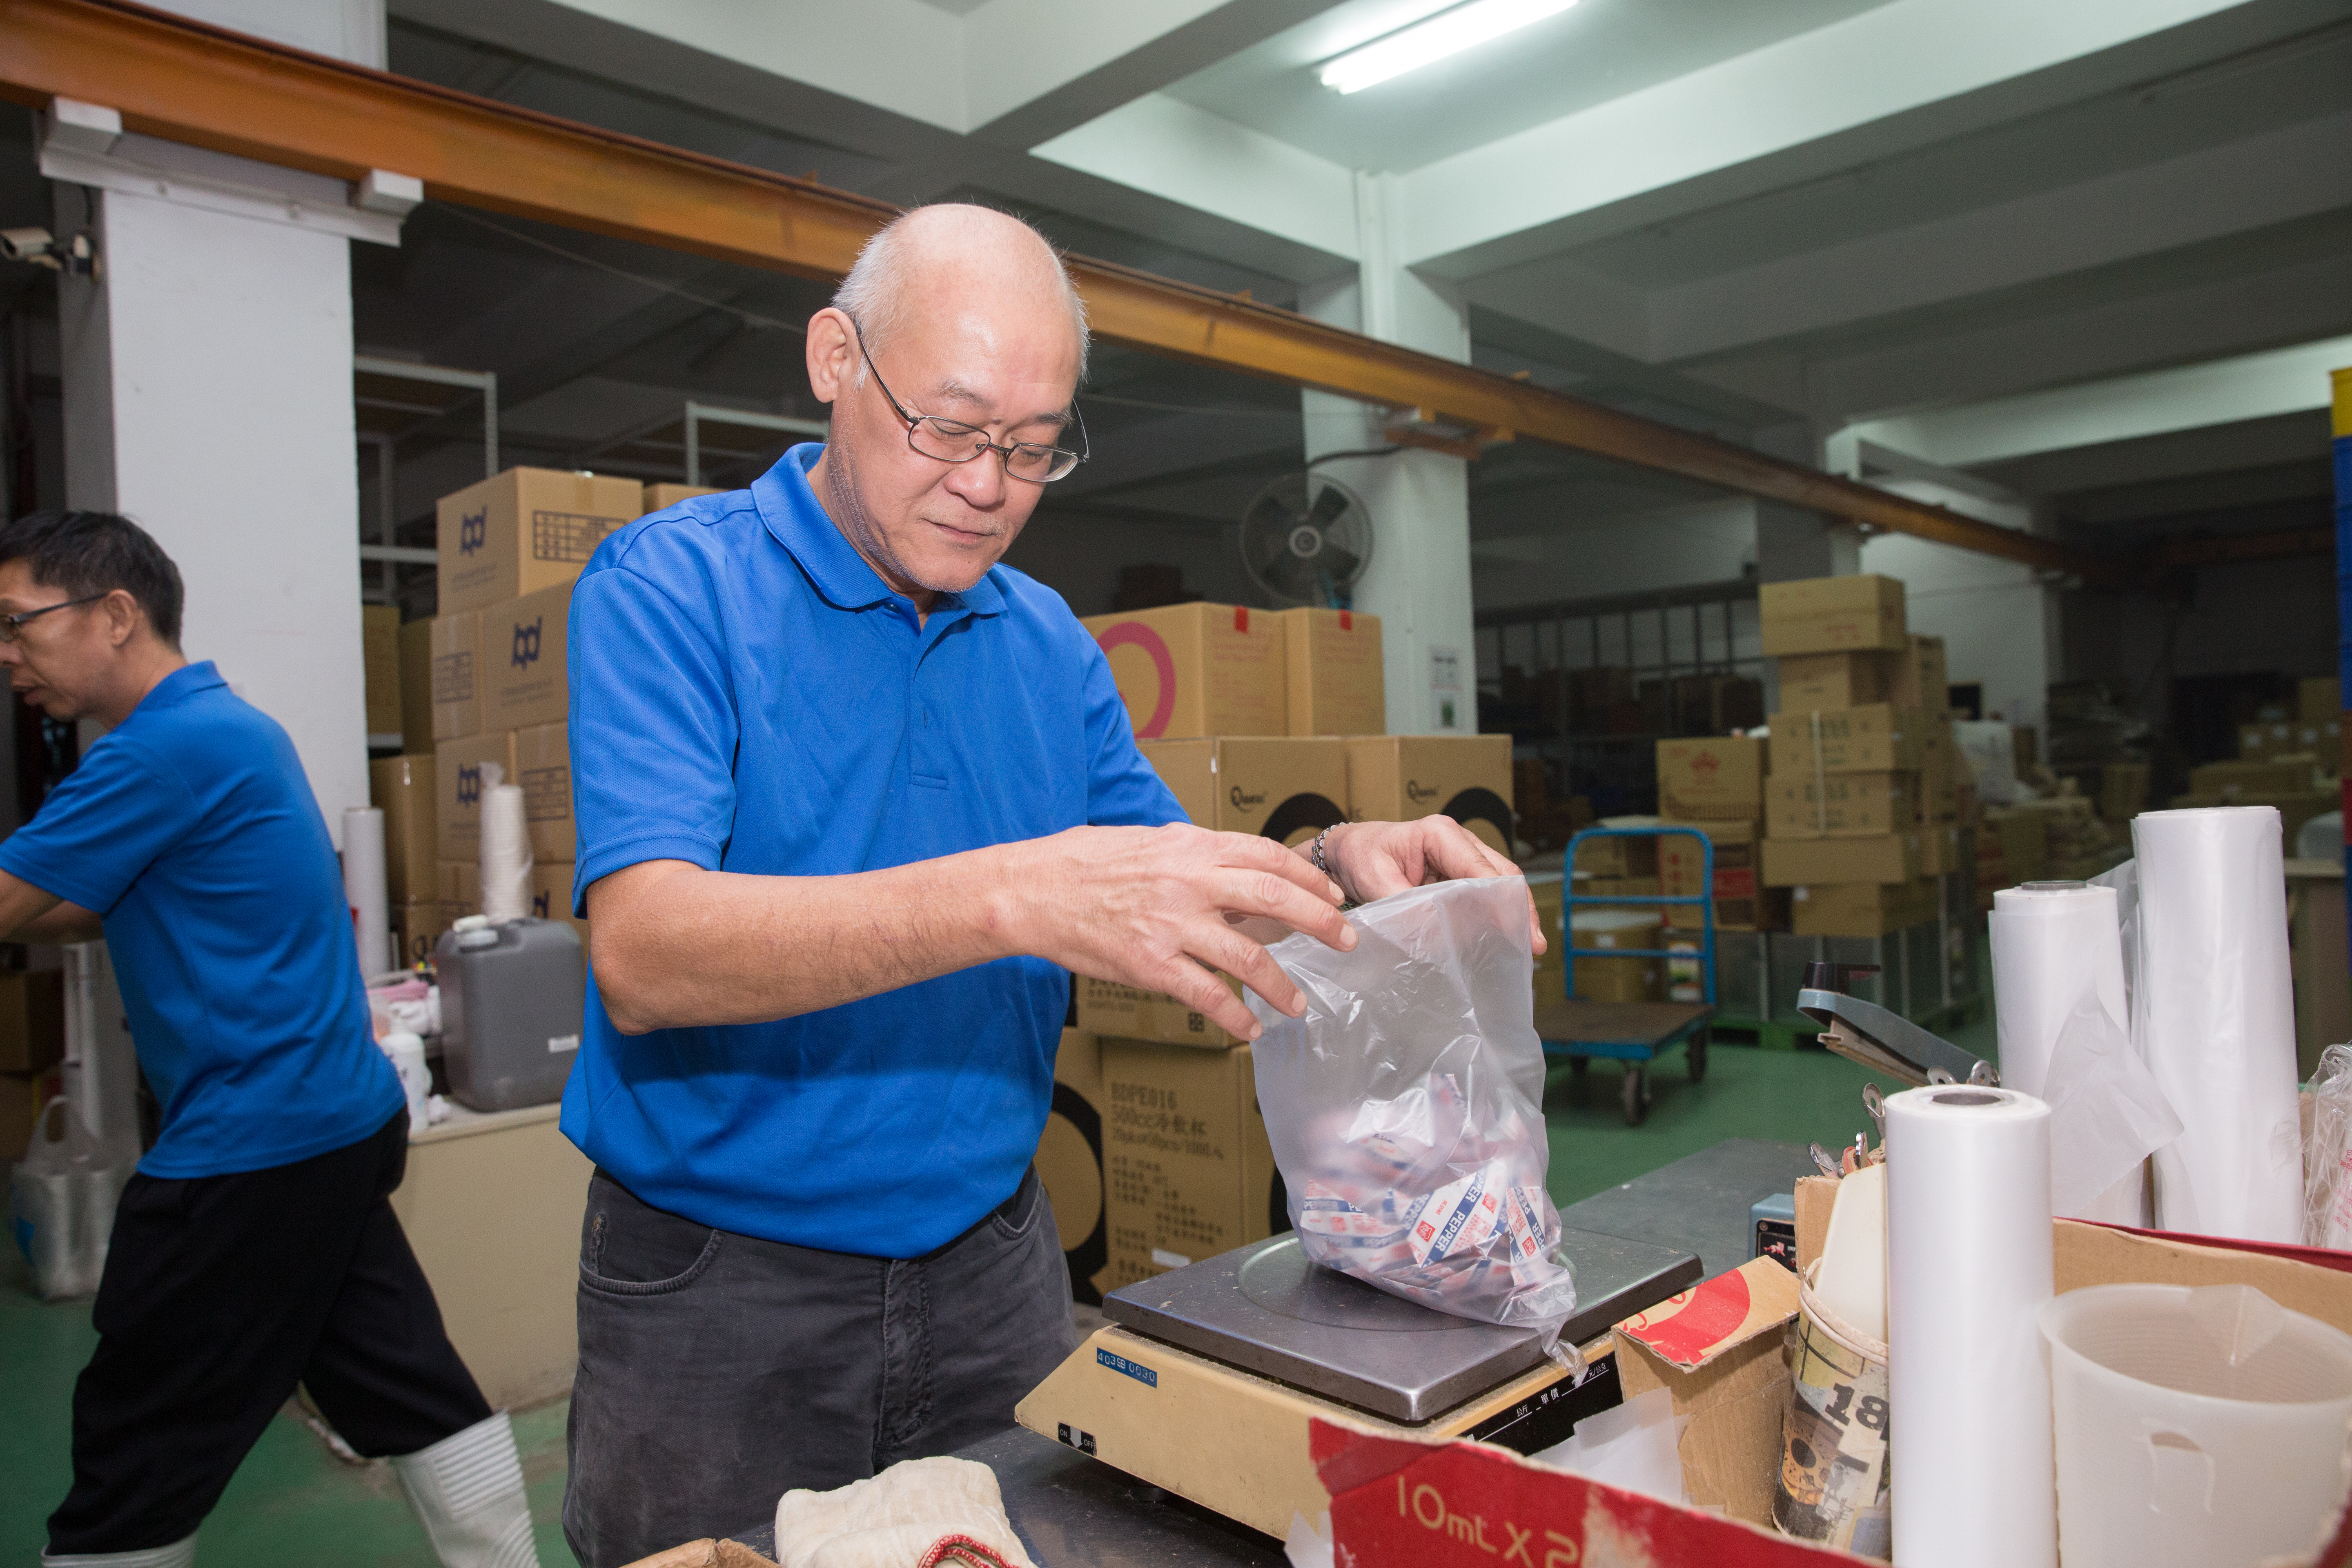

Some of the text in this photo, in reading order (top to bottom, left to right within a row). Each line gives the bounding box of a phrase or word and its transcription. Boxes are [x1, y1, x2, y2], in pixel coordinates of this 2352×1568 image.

[1434, 1210, 1466, 1252] PEPPER
[1129, 1363, 1155, 1381] 0030
[1517, 1404, 1528, 1417] 公斤
[1541, 1388, 1559, 1405] 單價
[1588, 1363, 1607, 1379] 元/公克
[1825, 1382, 1890, 1431] 18
[1060, 1429, 1094, 1448] ON OFF
